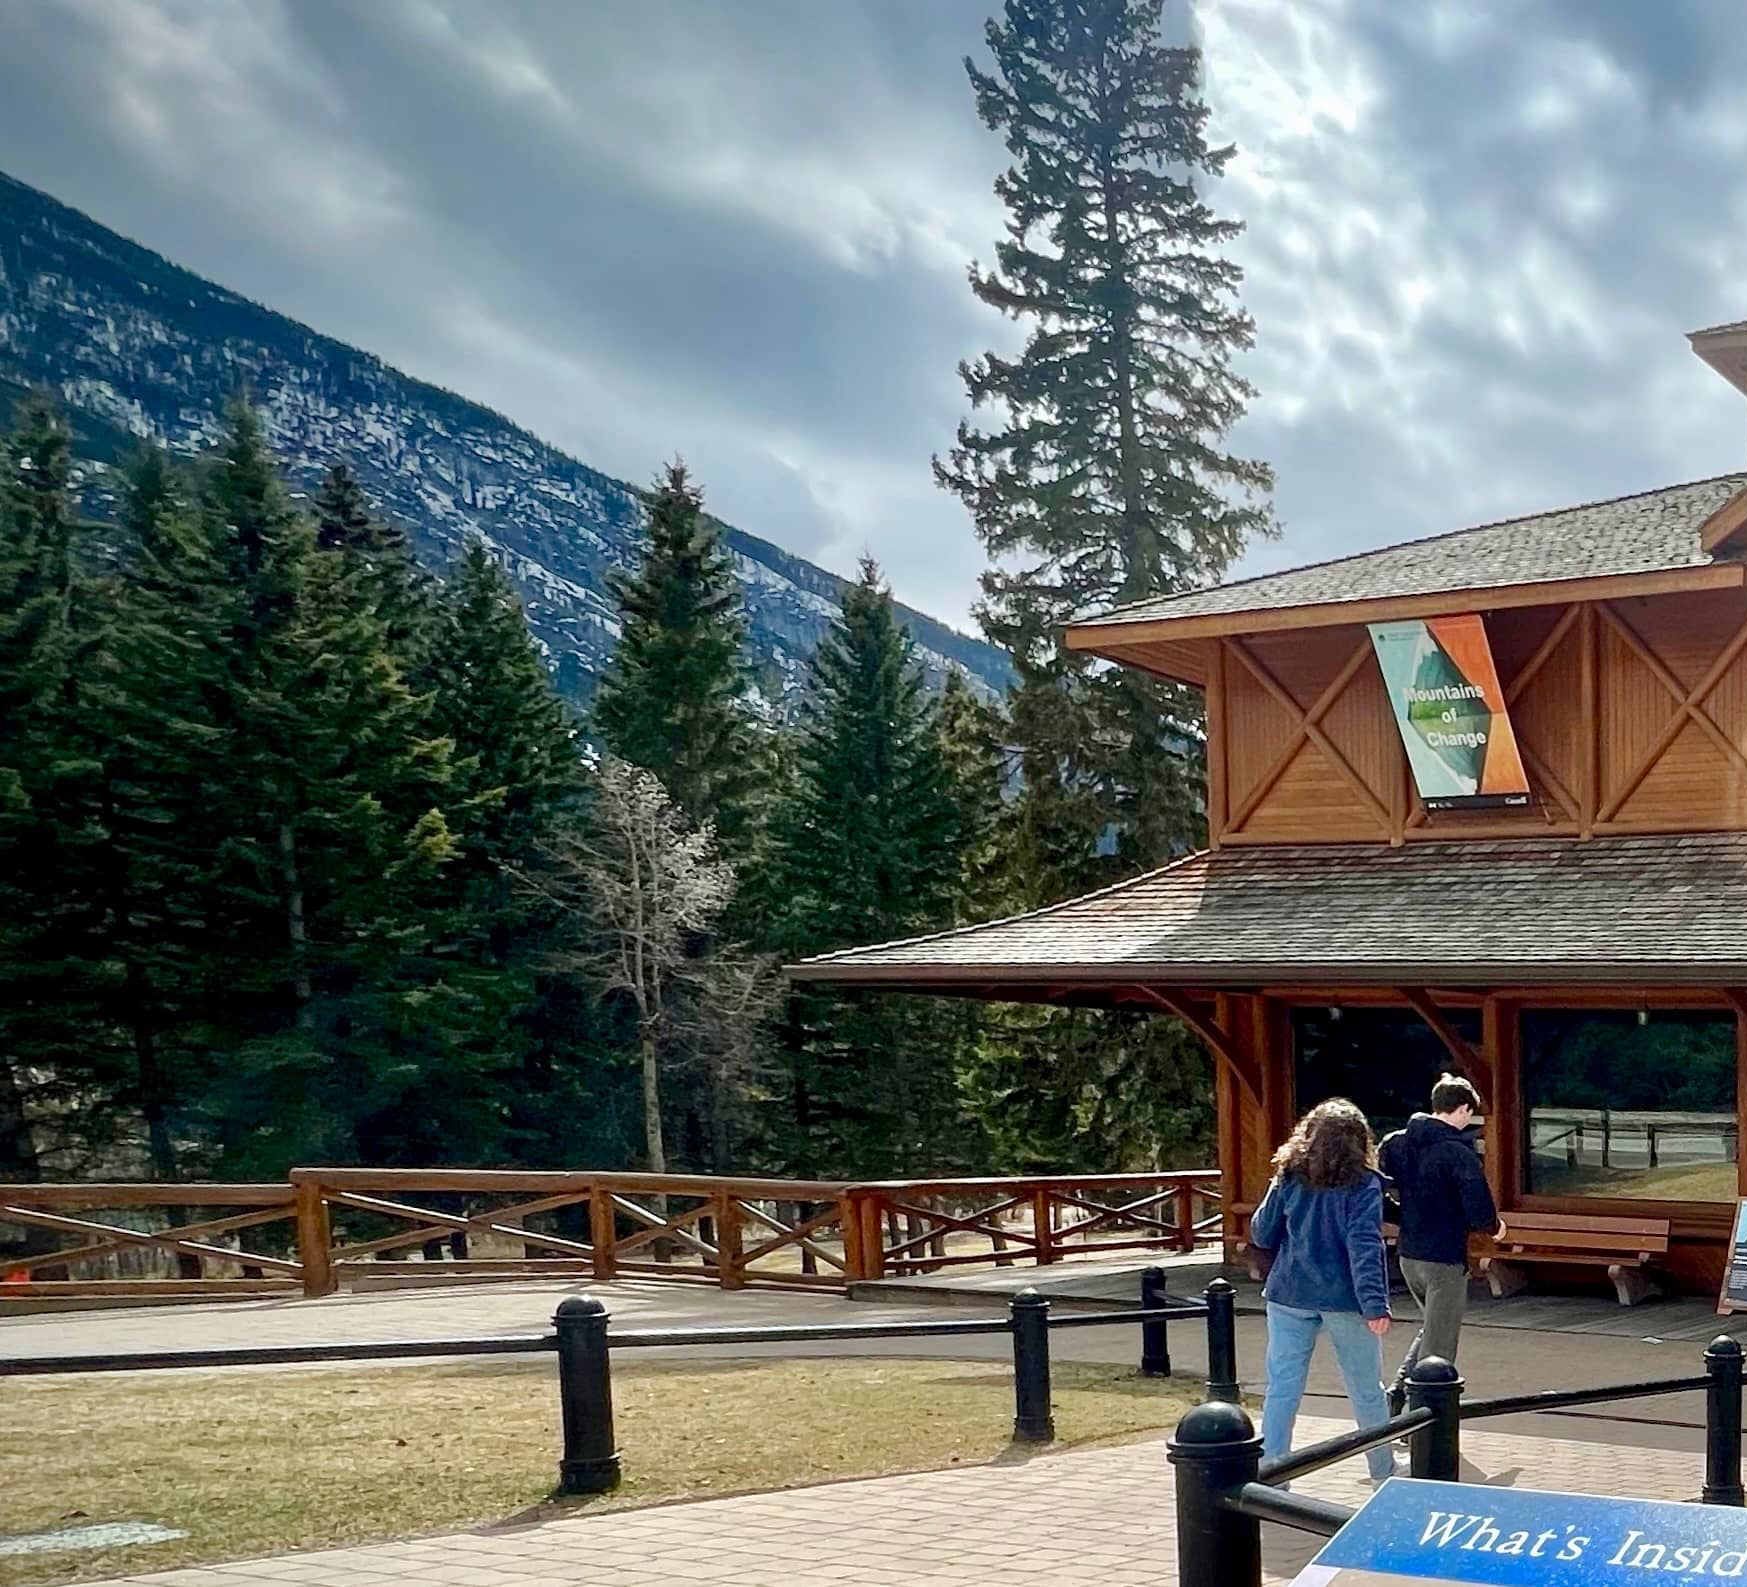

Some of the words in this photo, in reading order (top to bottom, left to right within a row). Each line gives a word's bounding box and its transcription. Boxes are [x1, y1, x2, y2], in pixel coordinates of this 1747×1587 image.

[1402, 683, 1485, 703] Mountains
[1441, 707, 1457, 723] of
[1426, 731, 1487, 749] Change
[1418, 1511, 1592, 1562] What's
